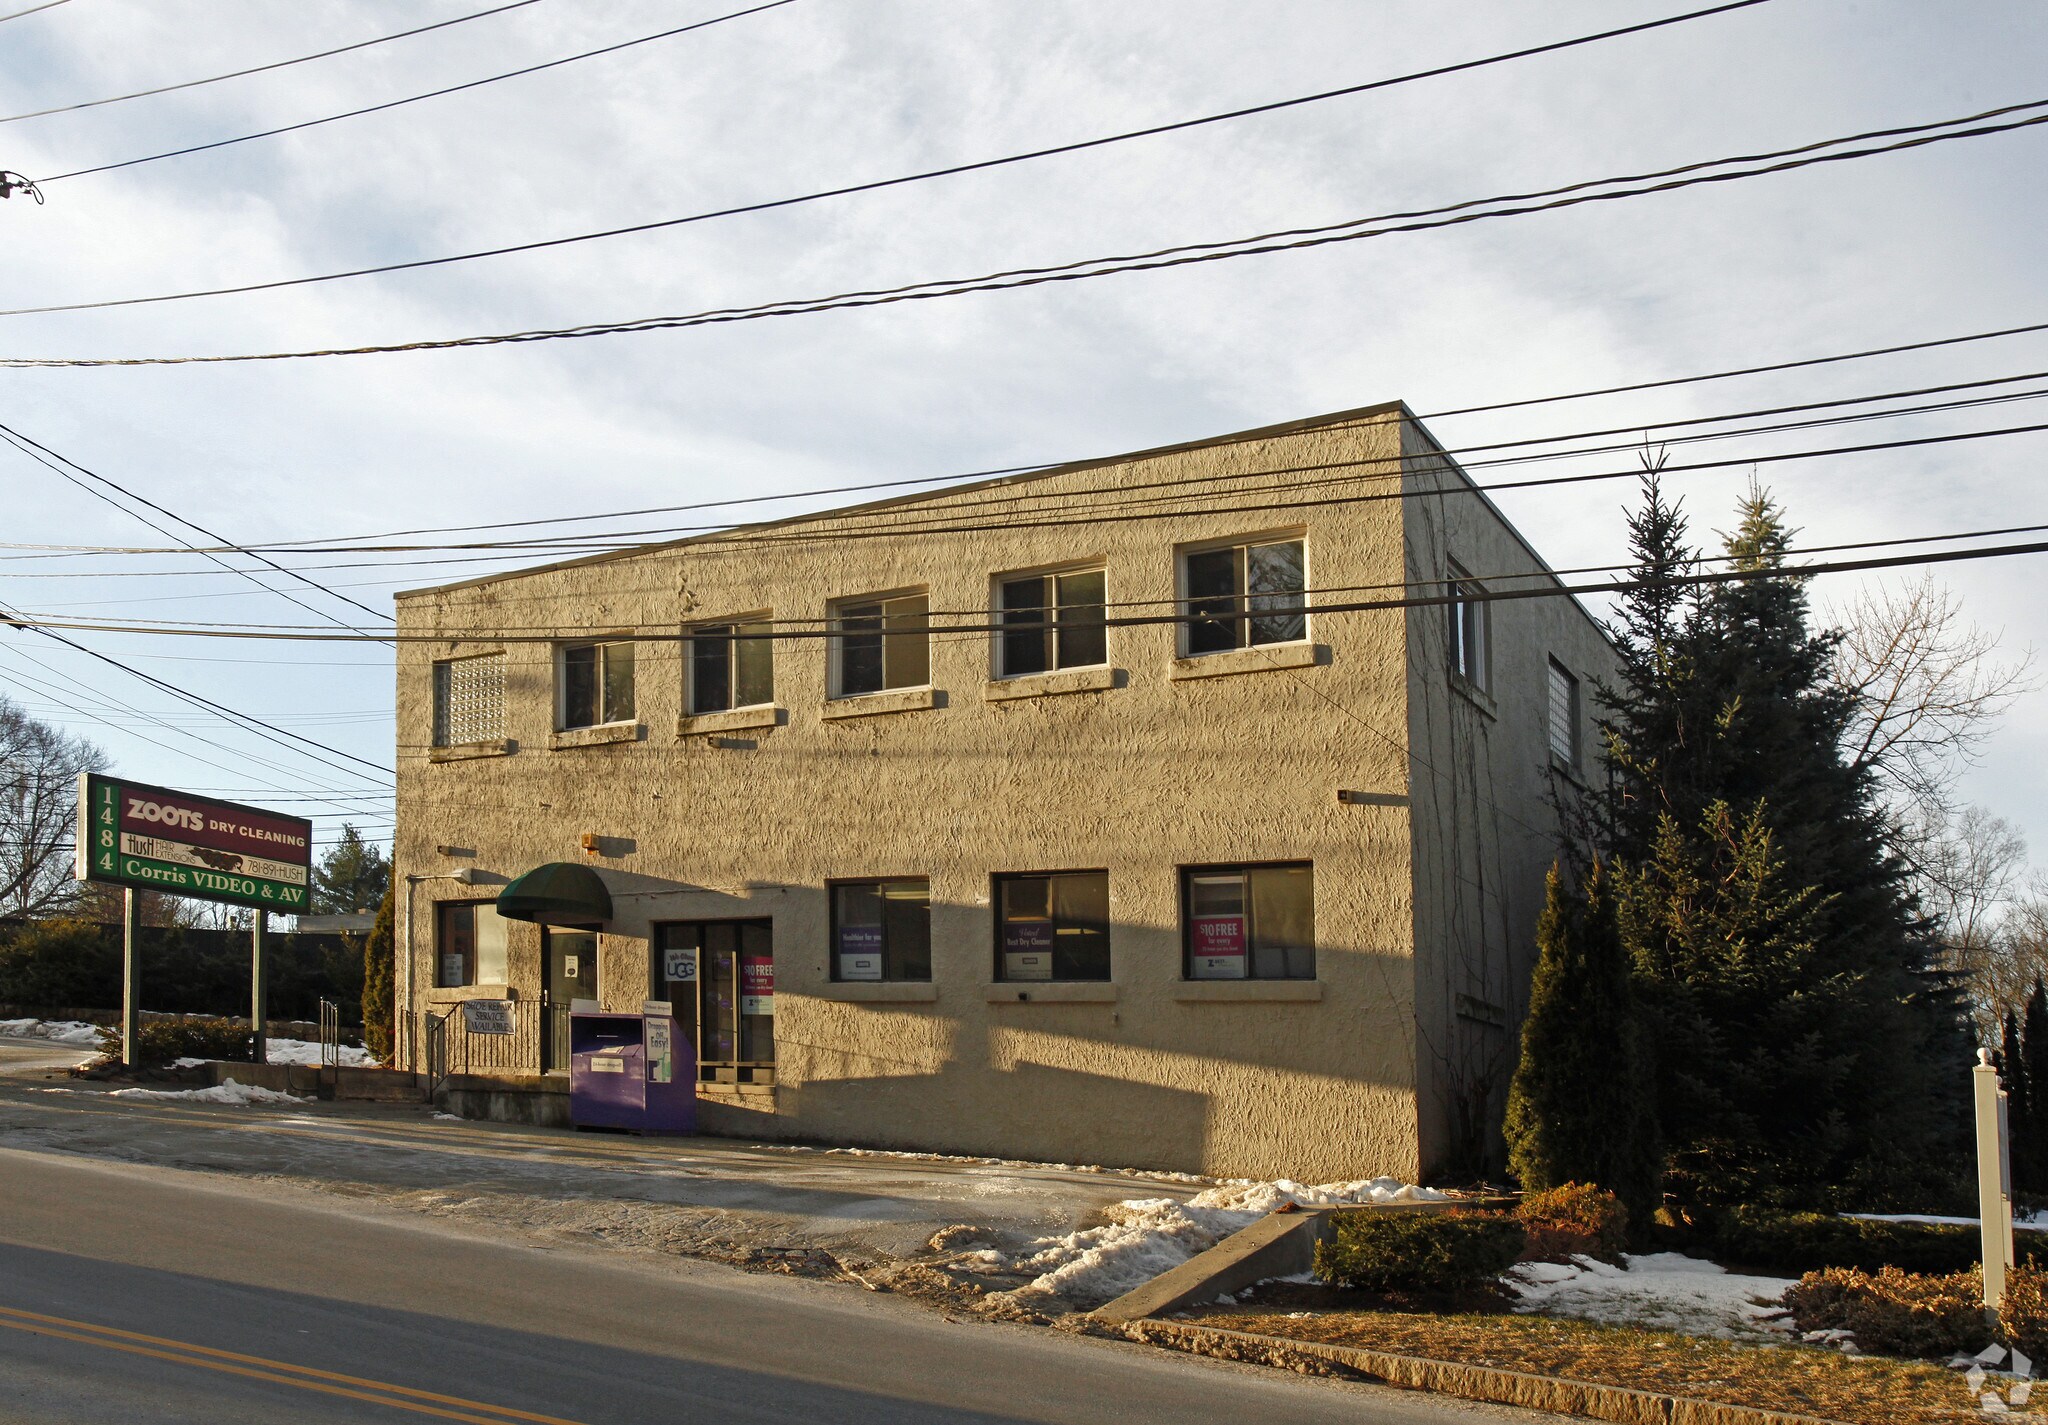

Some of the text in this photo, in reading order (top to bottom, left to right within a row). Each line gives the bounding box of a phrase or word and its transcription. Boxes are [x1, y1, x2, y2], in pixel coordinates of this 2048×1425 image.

[99, 786, 114, 870] 1484
[127, 798, 305, 847] ZOOTS DRY CLEANING
[155, 840, 175, 852] HAIR
[155, 851, 196, 864] EXTENSIONS
[126, 859, 304, 903] Corris VIDEO & AV
[1200, 923, 1238, 936] $10 FREE
[1019, 937, 1030, 948] Dry
[1216, 938, 1231, 946] every
[756, 964, 774, 976] FREE
[465, 1001, 513, 1011] SHOE REPAIR
[474, 1011, 505, 1021] SERVICE
